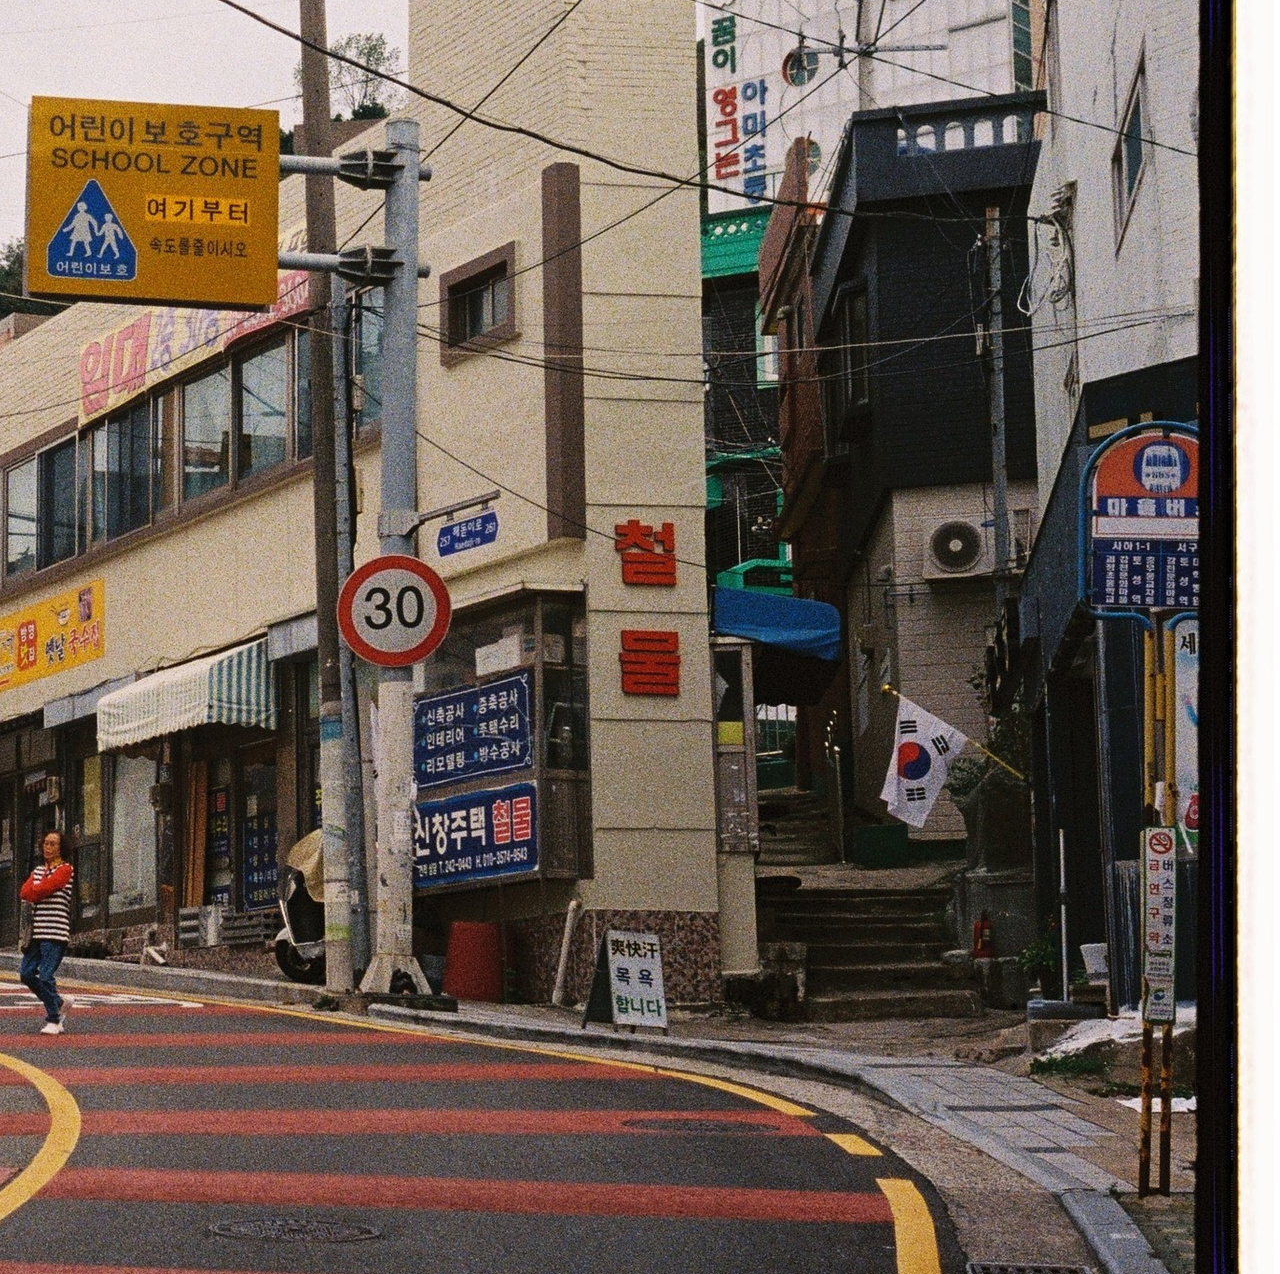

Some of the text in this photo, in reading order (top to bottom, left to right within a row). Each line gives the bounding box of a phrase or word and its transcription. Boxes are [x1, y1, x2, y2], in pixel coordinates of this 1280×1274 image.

[711, 15, 740, 180] 꿈이 영그는
[51, 148, 258, 179] SCHOOL ZONE
[147, 198, 249, 224] 여기부터
[56, 261, 129, 276] 어린이보호
[80, 311, 152, 415] 임대
[1107, 498, 1199, 517] 마을버
[452, 519, 483, 537] 해돋이로
[364, 585, 424, 630] 30
[615, 519, 680, 696] 철물
[478, 688, 518, 714] 증축공사
[426, 702, 465, 726] 신축공사
[478, 713, 519, 736] 주택수리
[426, 727, 465, 749] 인테리어
[426, 750, 465, 774] 리모델링
[479, 739, 521, 763] 방수공사
[414, 796, 531, 857] 신창주택 철물
[1148, 859, 1161, 944] 금연구역
[1161, 859, 1175, 945] 버스정류소
[611, 938, 658, 959] 爽快汗
[615, 994, 662, 1017] 합니다
